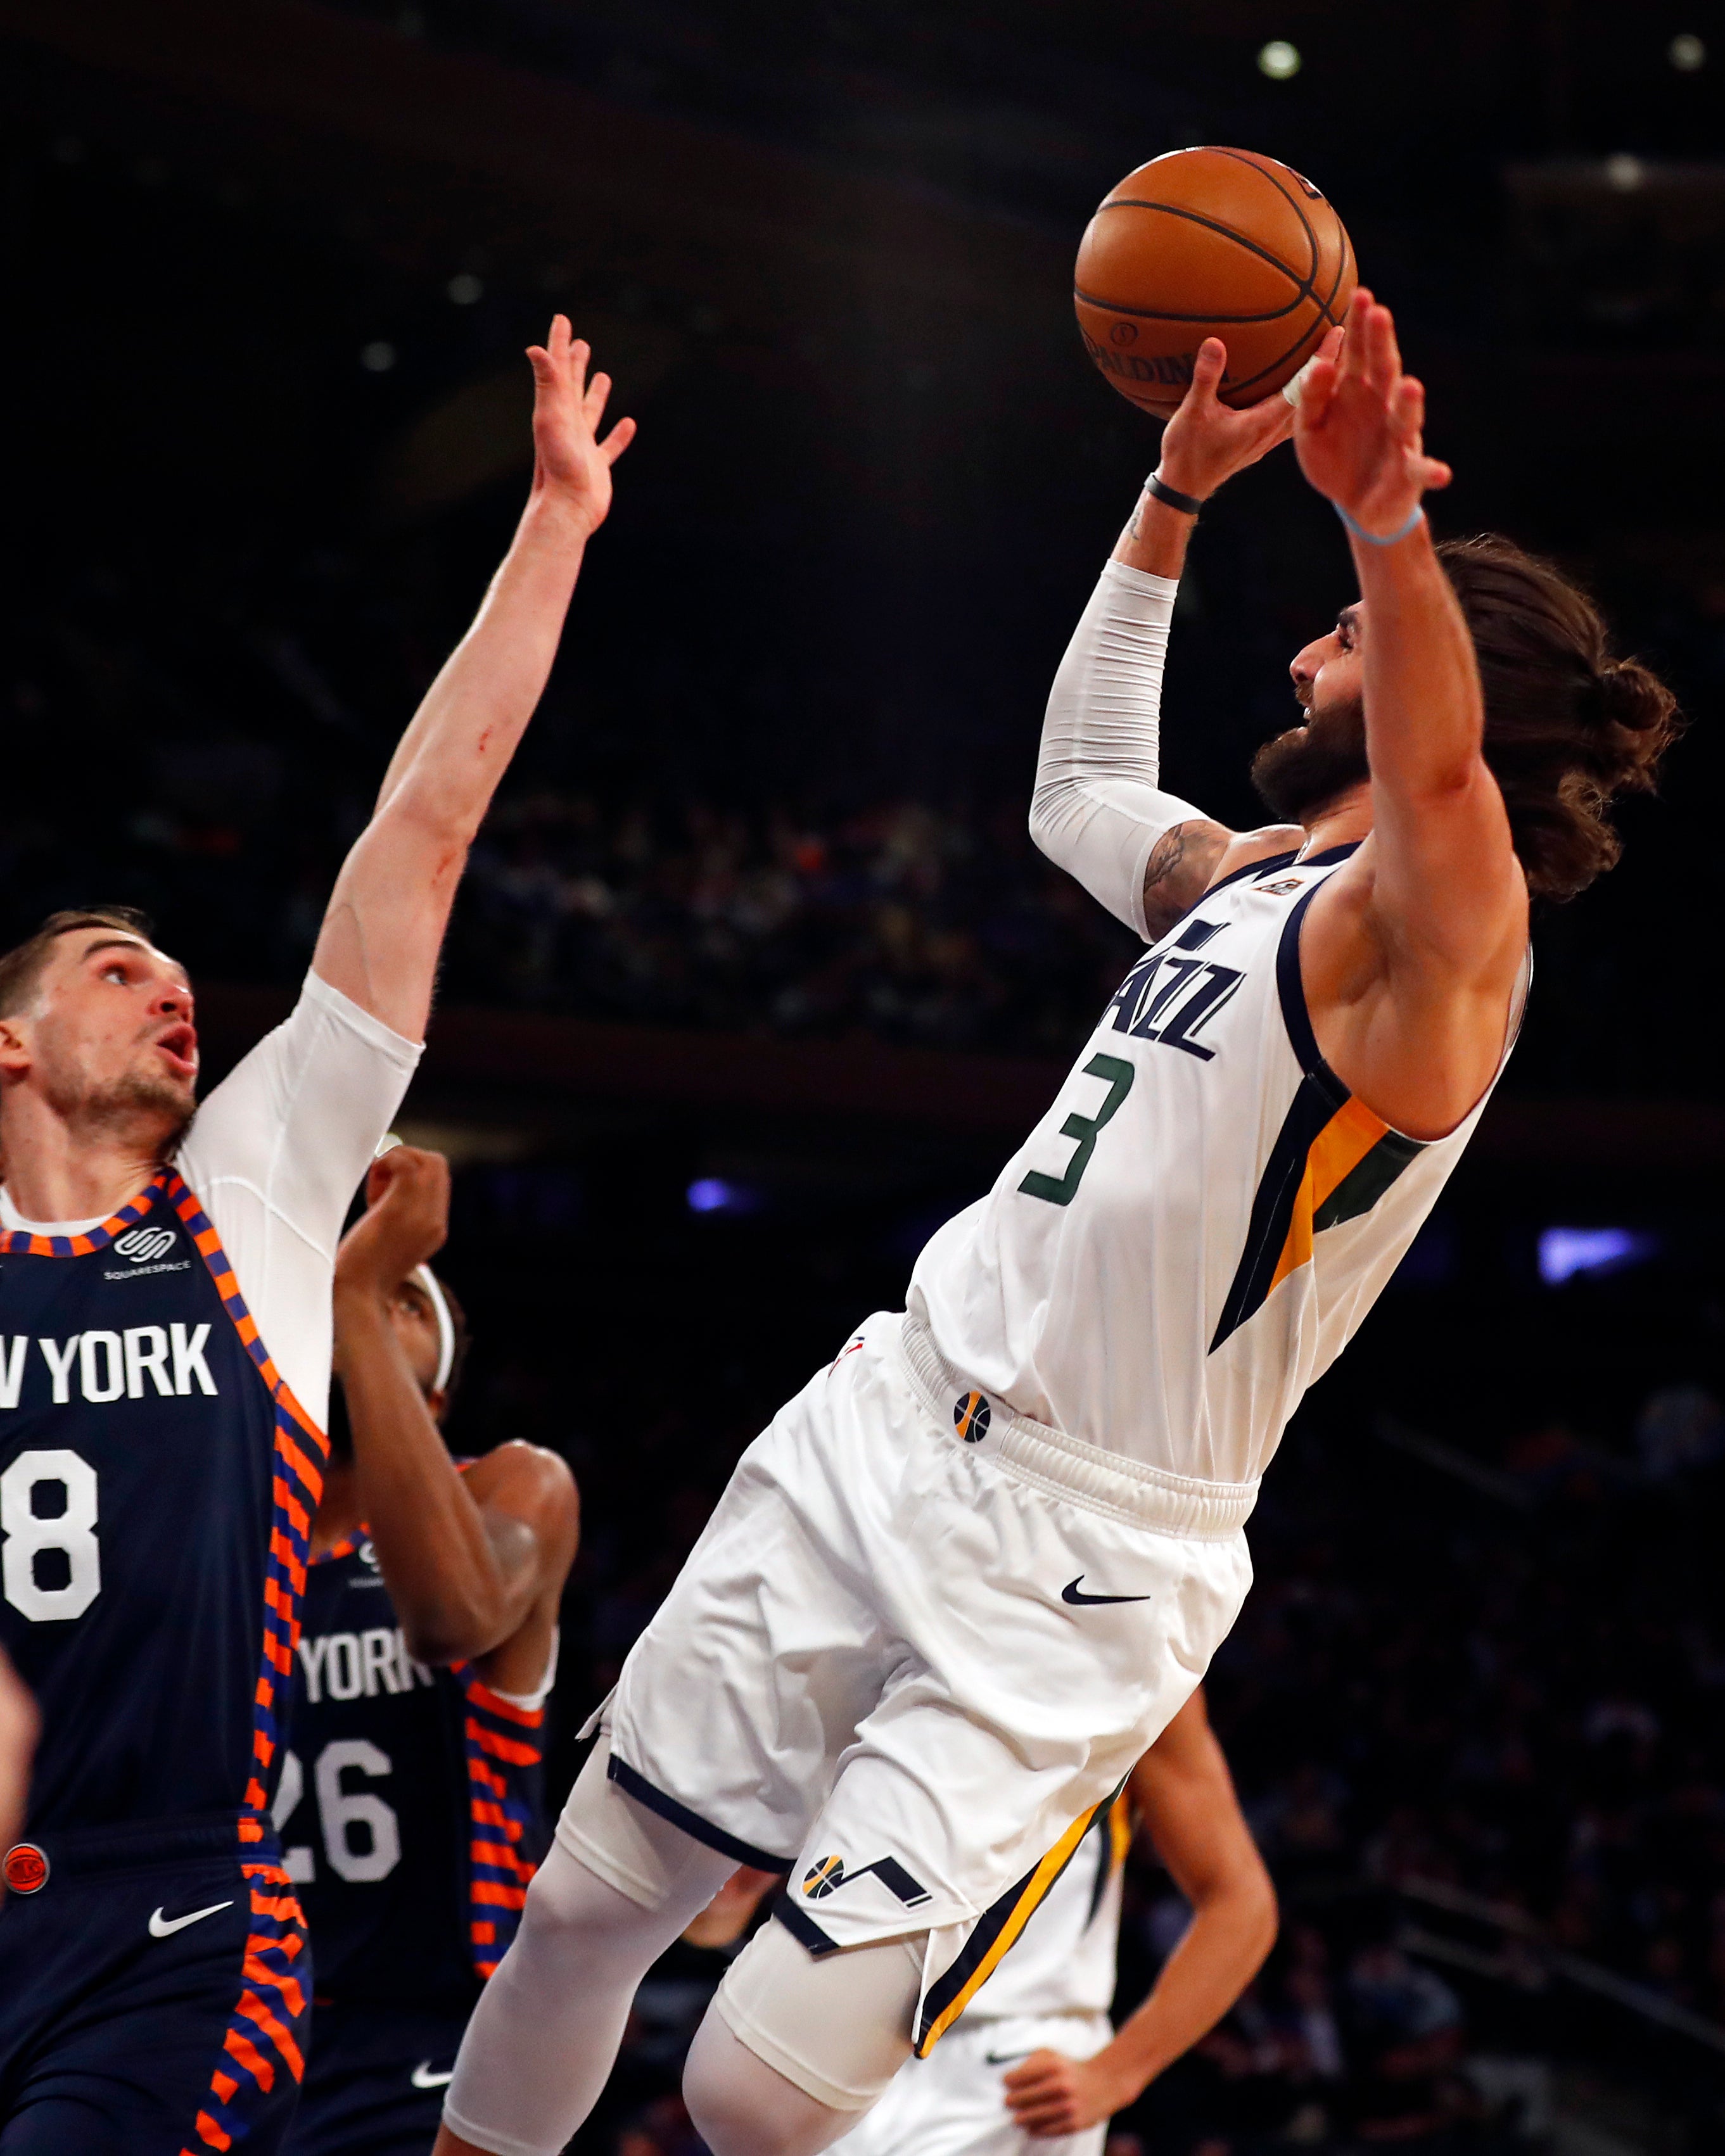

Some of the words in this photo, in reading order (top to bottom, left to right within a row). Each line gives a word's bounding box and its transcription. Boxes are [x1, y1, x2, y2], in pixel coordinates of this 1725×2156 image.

[1017, 1052, 1135, 1207] 3
[38, 1322, 219, 1404] YORK
[1, 1449, 101, 1622] 8
